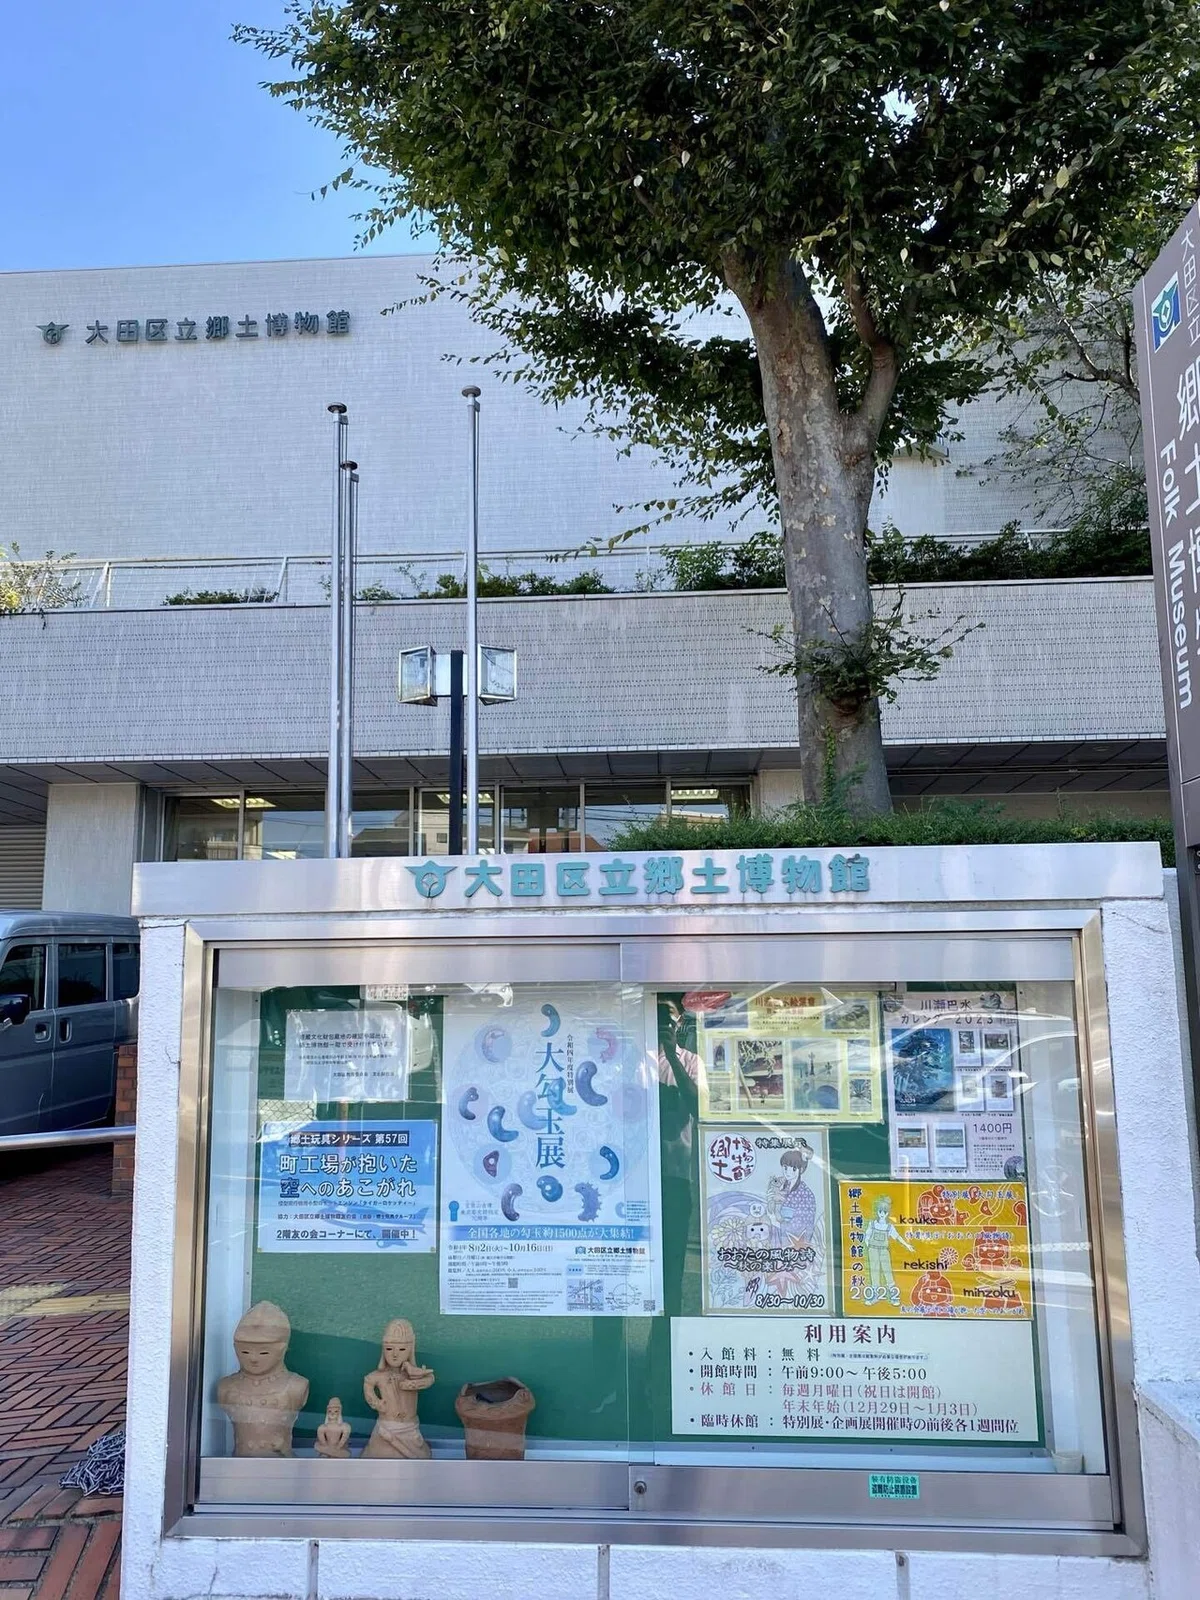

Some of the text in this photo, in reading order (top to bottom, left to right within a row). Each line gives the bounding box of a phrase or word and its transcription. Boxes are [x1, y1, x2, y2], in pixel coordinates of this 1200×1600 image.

[85, 309, 352, 345] 大田区立郷土博物館
[1160, 438, 1193, 710] Folk Museum
[464, 853, 872, 899] 大田区立郷土博物館
[955, 1013, 994, 1024] 2023
[535, 1043, 566, 1169] 大勾玉展
[973, 1122, 1012, 1135] 1400円
[289, 1133, 408, 1146] 郷土玩具シリーズ 第57回
[280, 1154, 418, 1175] 町工場が抱いた
[279, 1177, 416, 1198] 空へのあこがれ
[848, 1187, 866, 1286] 郷土博物館の秋
[717, 1247, 816, 1262] おおたの風物詩
[904, 1259, 948, 1271] rekishi
[849, 1286, 901, 1301] 2022
[963, 1285, 1016, 1299] minzoku
[804, 1324, 896, 1344] 利用案内
[783, 1415, 1019, 1434] 特別展・企画展開催時の前後各1週間位
